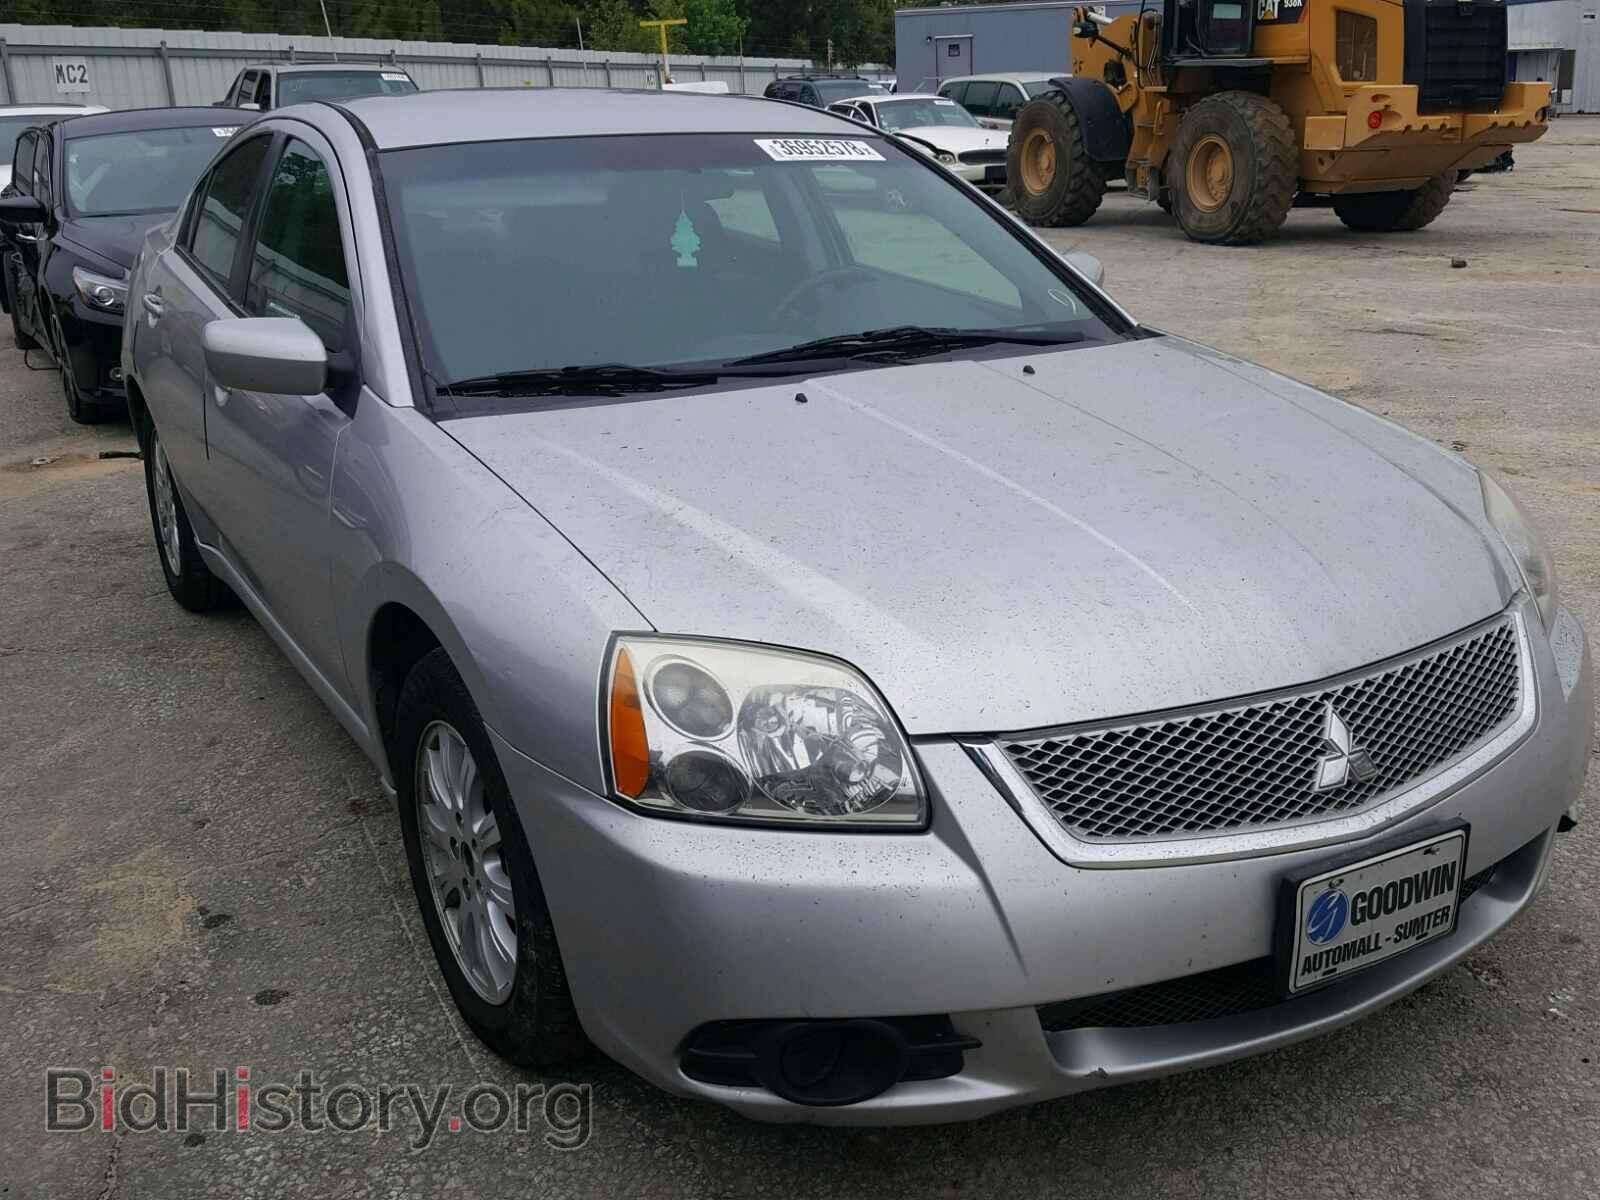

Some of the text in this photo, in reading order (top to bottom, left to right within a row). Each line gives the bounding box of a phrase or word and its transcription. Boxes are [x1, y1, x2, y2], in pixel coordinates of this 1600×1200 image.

[1257, 0, 1280, 20] CAT
[55, 63, 88, 84] MC2
[1350, 861, 1457, 926] GOODWIN
[1301, 932, 1382, 976] AUTOMALL
[1394, 905, 1451, 944] SUMTER
